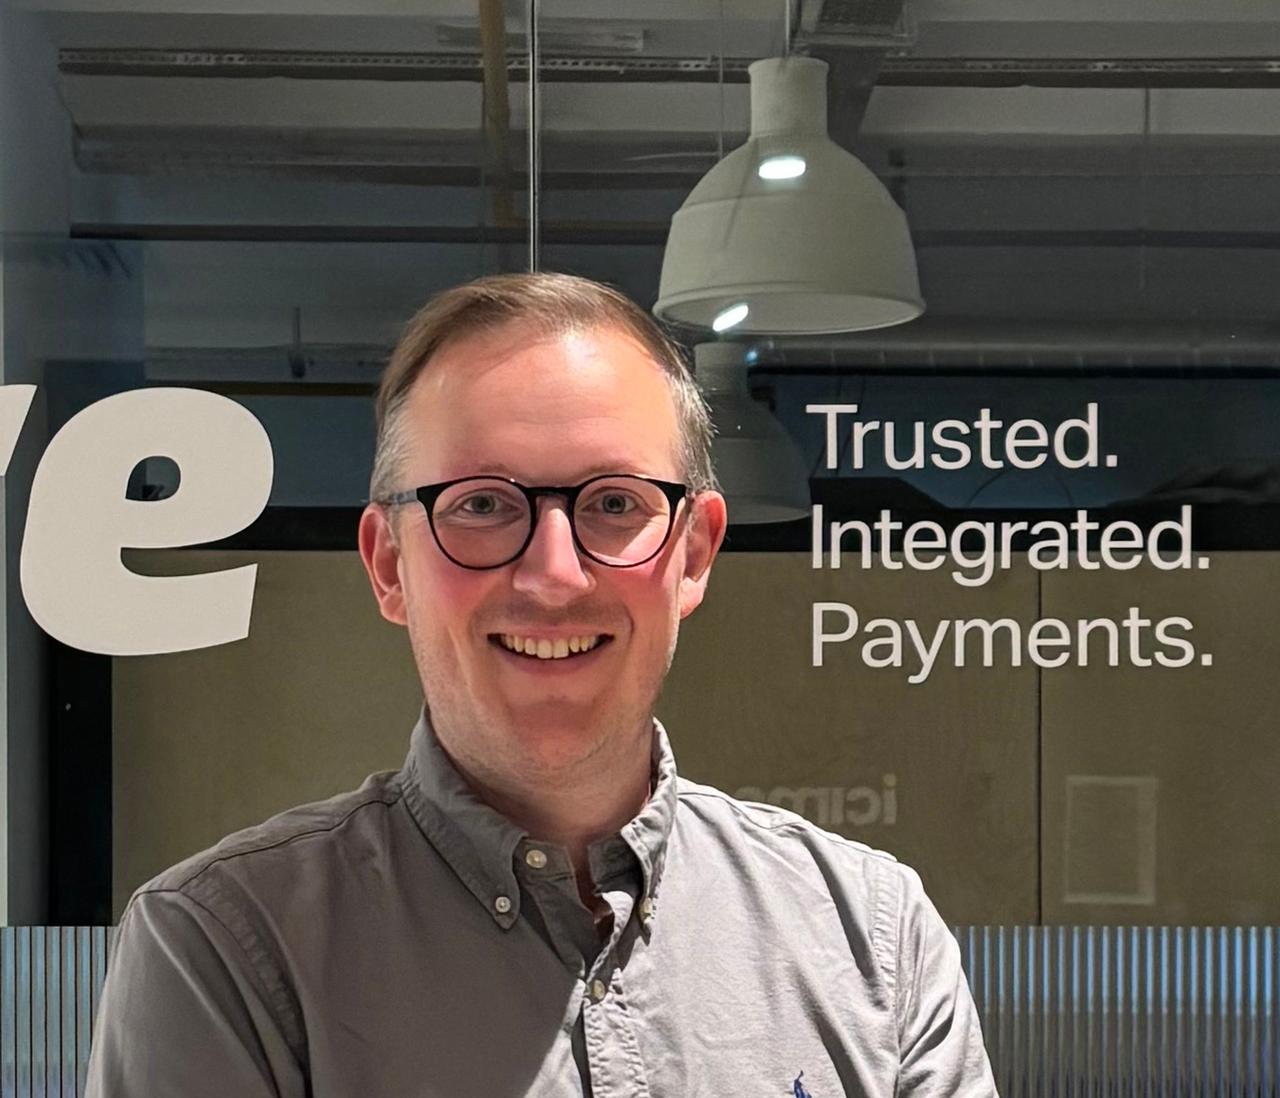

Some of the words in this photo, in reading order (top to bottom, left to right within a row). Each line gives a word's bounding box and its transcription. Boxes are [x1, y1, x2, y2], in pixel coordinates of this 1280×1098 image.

[806, 402, 1118, 470] Trusted.
[812, 504, 1210, 587] Integrated.
[812, 602, 1212, 684] Payments.
